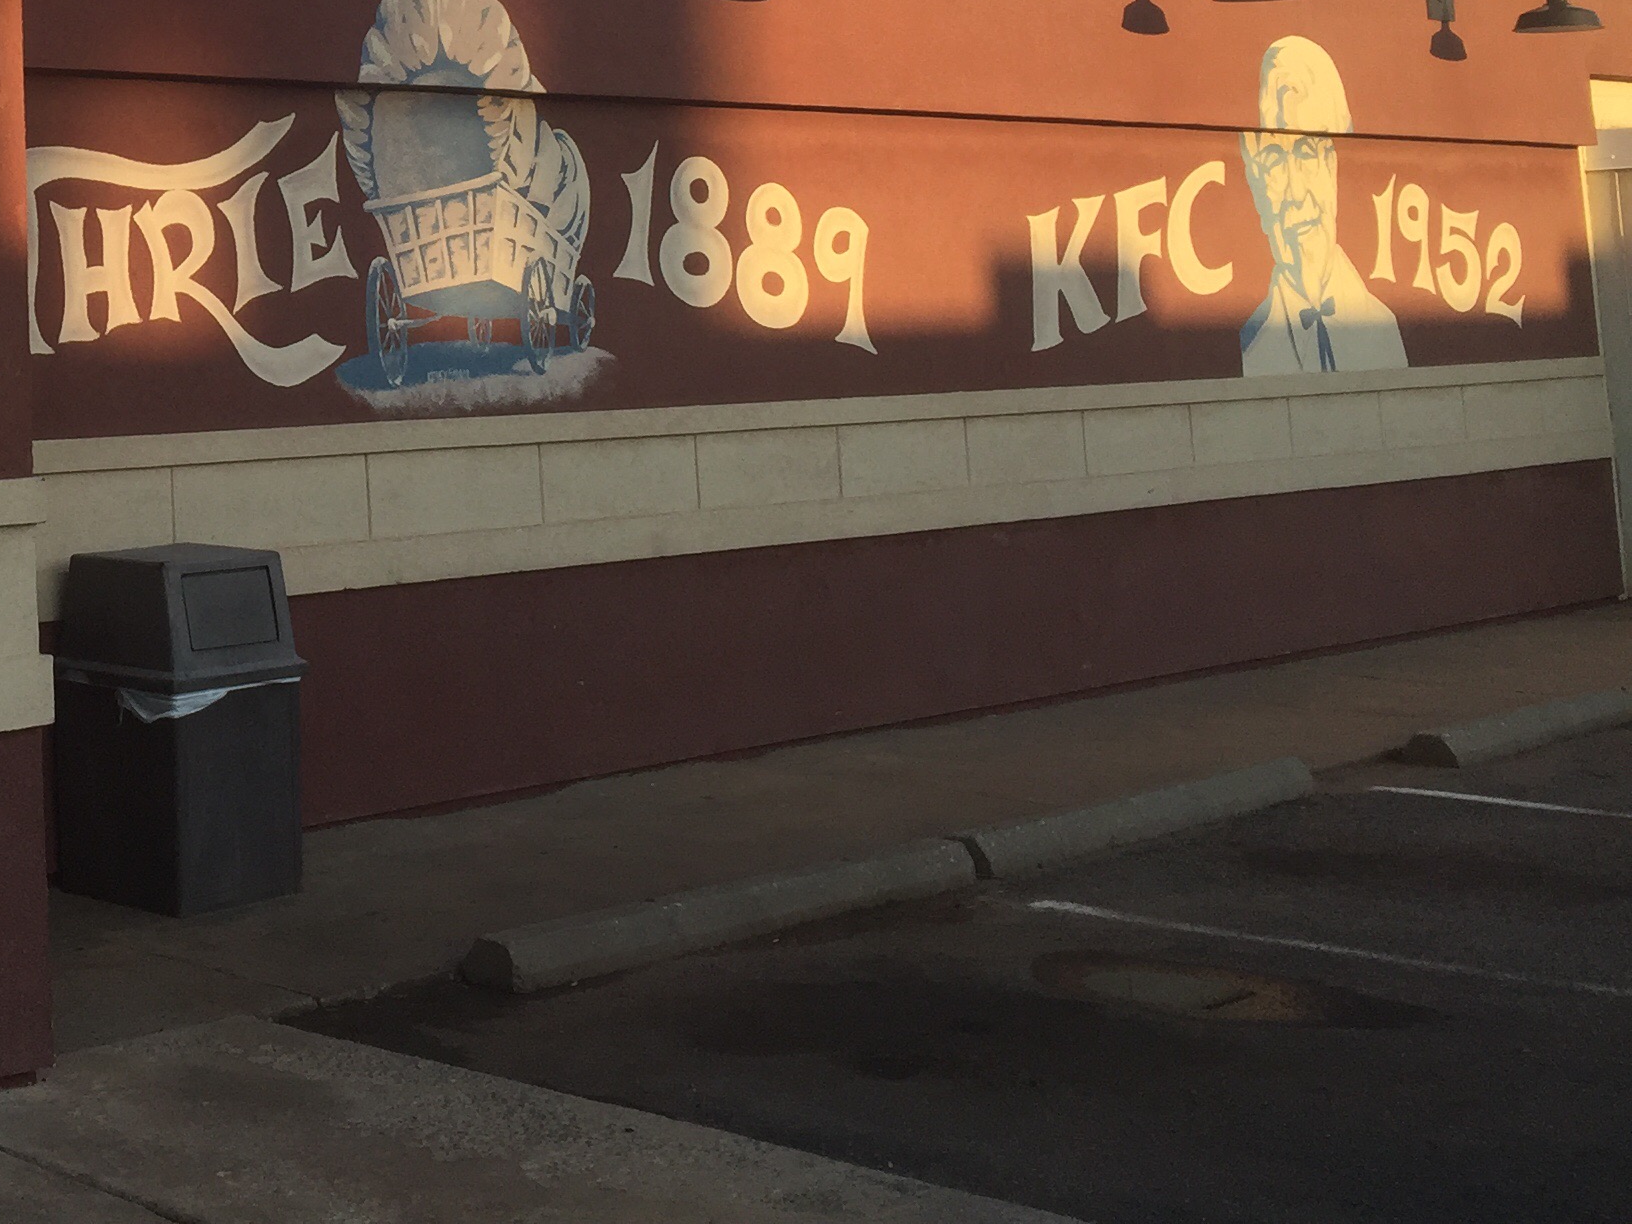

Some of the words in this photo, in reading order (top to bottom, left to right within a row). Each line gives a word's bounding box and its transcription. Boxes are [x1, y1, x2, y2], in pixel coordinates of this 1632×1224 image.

[613, 139, 878, 356] 1889
[1025, 160, 1234, 352] KFC
[1369, 173, 1527, 329] 1952
